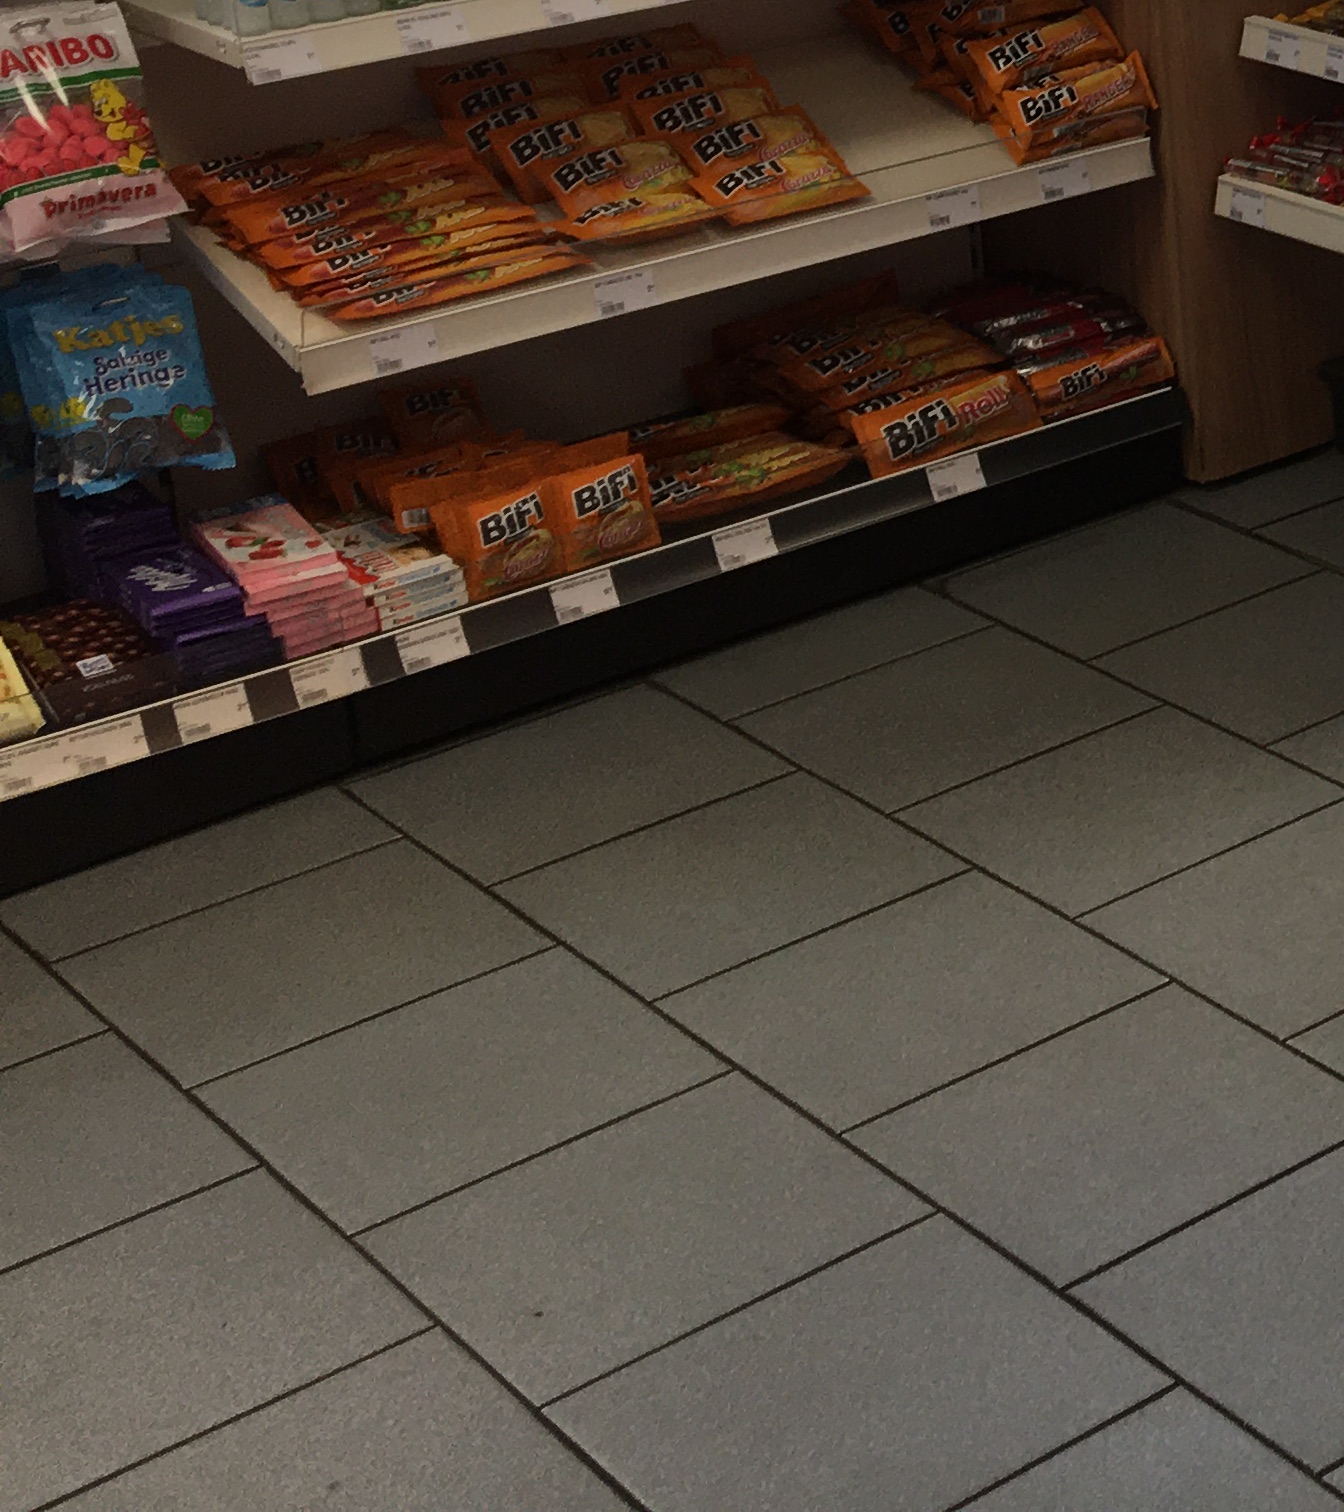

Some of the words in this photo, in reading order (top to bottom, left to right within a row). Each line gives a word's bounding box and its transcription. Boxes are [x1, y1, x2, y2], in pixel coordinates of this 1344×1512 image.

[1020, 85, 1078, 125] BiFi
[511, 118, 582, 166] BiFi
[695, 120, 763, 163] BiFi
[43, 181, 157, 220] Primavera
[54, 313, 184, 354] Katjes
[883, 395, 956, 460] BiFi
[957, 376, 1010, 425] Roll
